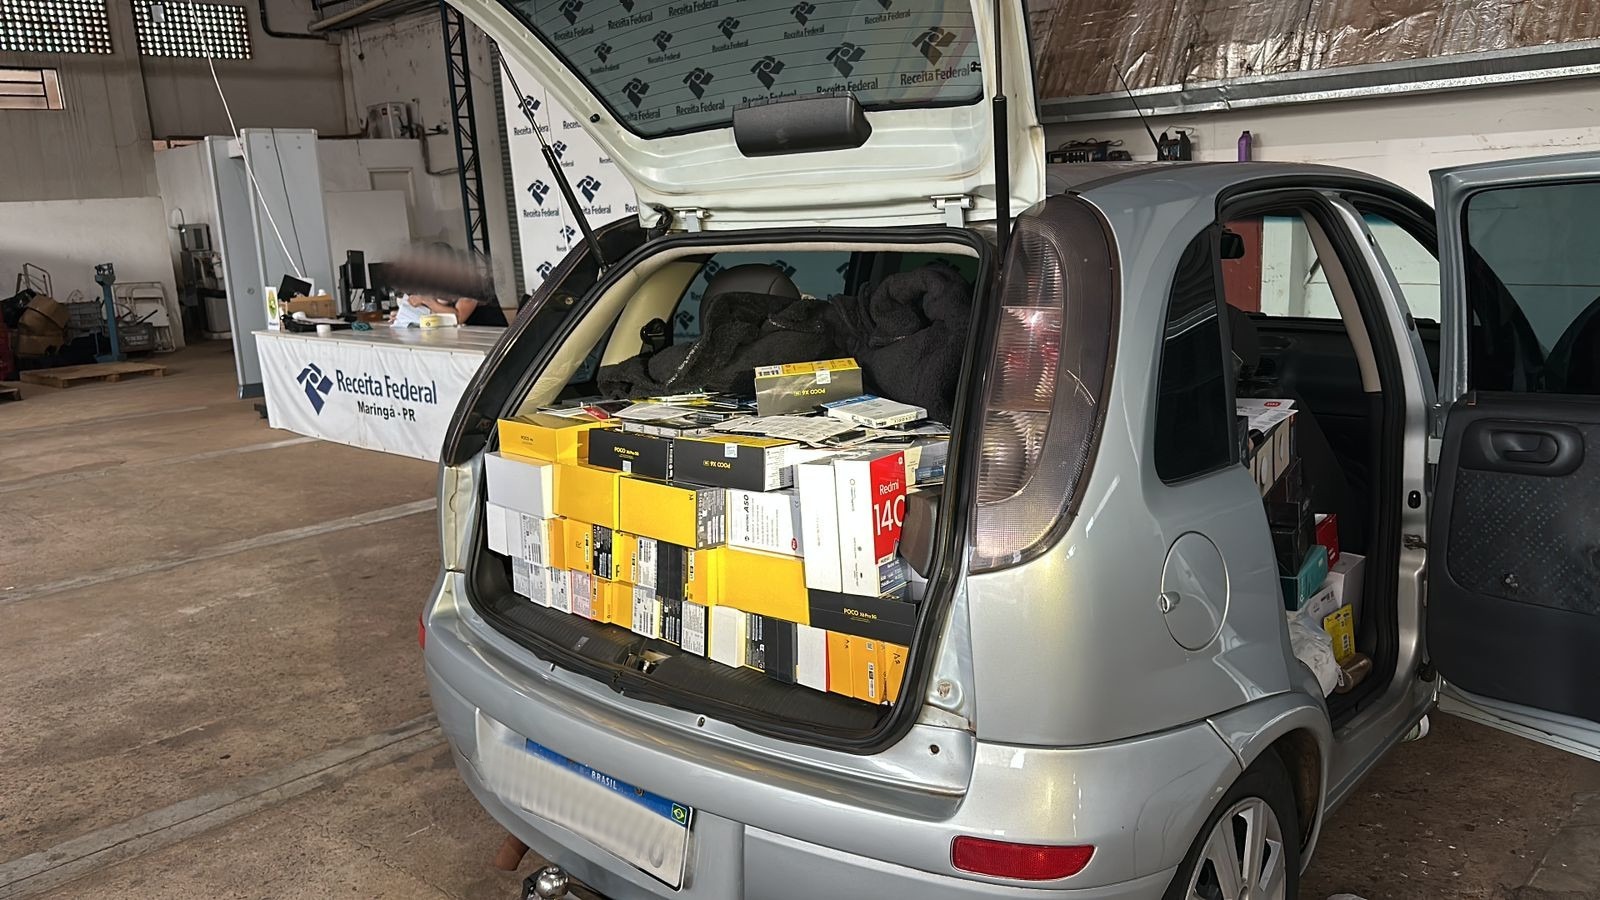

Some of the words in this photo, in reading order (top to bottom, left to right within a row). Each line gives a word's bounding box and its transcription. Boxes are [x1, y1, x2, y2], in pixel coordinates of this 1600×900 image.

[668, 4, 693, 17] Receita
[693, 0, 719, 13] Federal
[864, 14, 888, 25] Receita
[888, 9, 911, 20] Federal
[900, 71, 934, 86] Receita
[935, 63, 970, 80] Federal
[847, 78, 879, 92] Federal
[638, 108, 660, 120] Federal
[676, 104, 700, 116] Receita
[700, 100, 725, 113] Federal
[513, 126, 532, 136] Receita
[523, 208, 541, 218] Receita
[541, 207, 559, 217] Federal
[591, 205, 612, 214] Federal
[335, 369, 383, 397] Receita
[384, 375, 437, 404] Federal
[357, 400, 396, 420] Maringá
[402, 407, 416, 422] PR
[716, 461, 731, 469] POCO
[879, 479, 900, 496] Redmi
[873, 494, 906, 536] 14C
[843, 608, 859, 617] POCO
[591, 770, 618, 790] BRASIL
